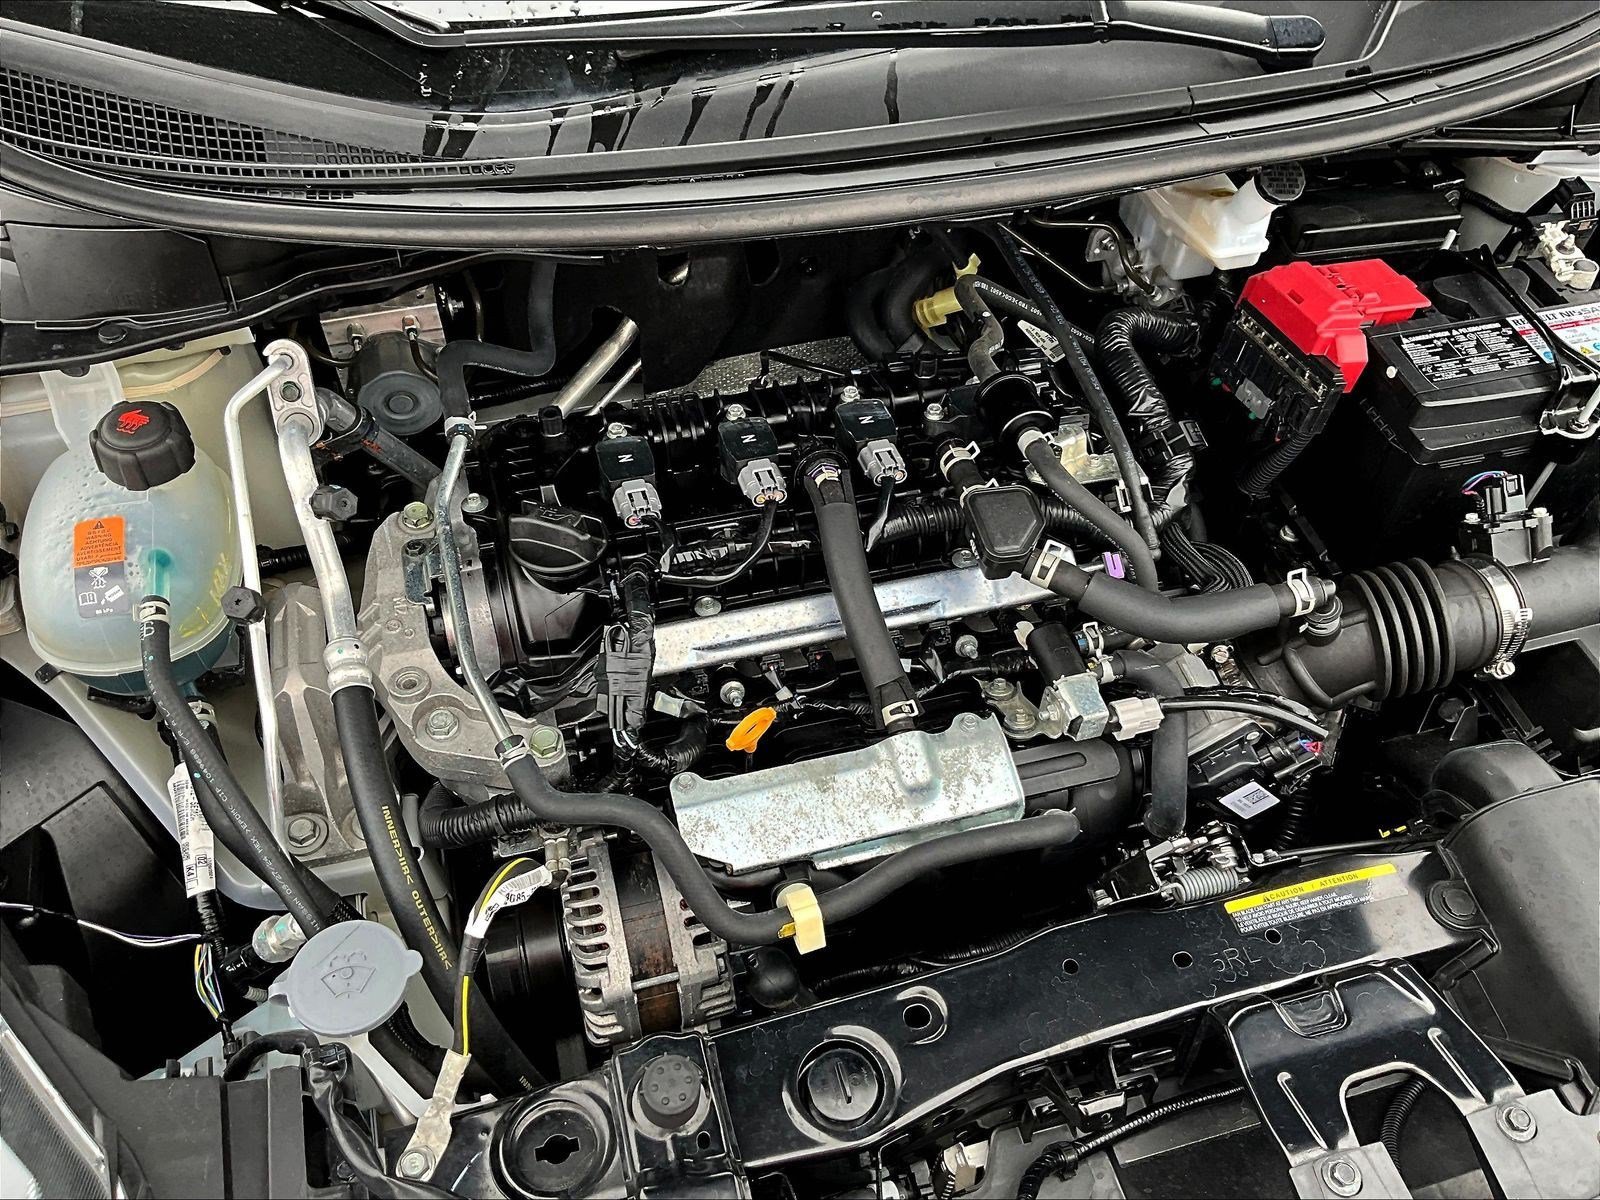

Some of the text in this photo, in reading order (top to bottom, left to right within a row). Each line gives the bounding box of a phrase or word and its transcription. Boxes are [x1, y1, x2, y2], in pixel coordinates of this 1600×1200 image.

[1559, 305, 1599, 318] NISSA
[249, 835, 264, 852] MEX
[197, 855, 207, 865] 02
[185, 865, 195, 876] K4
[1269, 886, 1304, 900] CAUTION
[1320, 874, 1358, 887] ATTENTION
